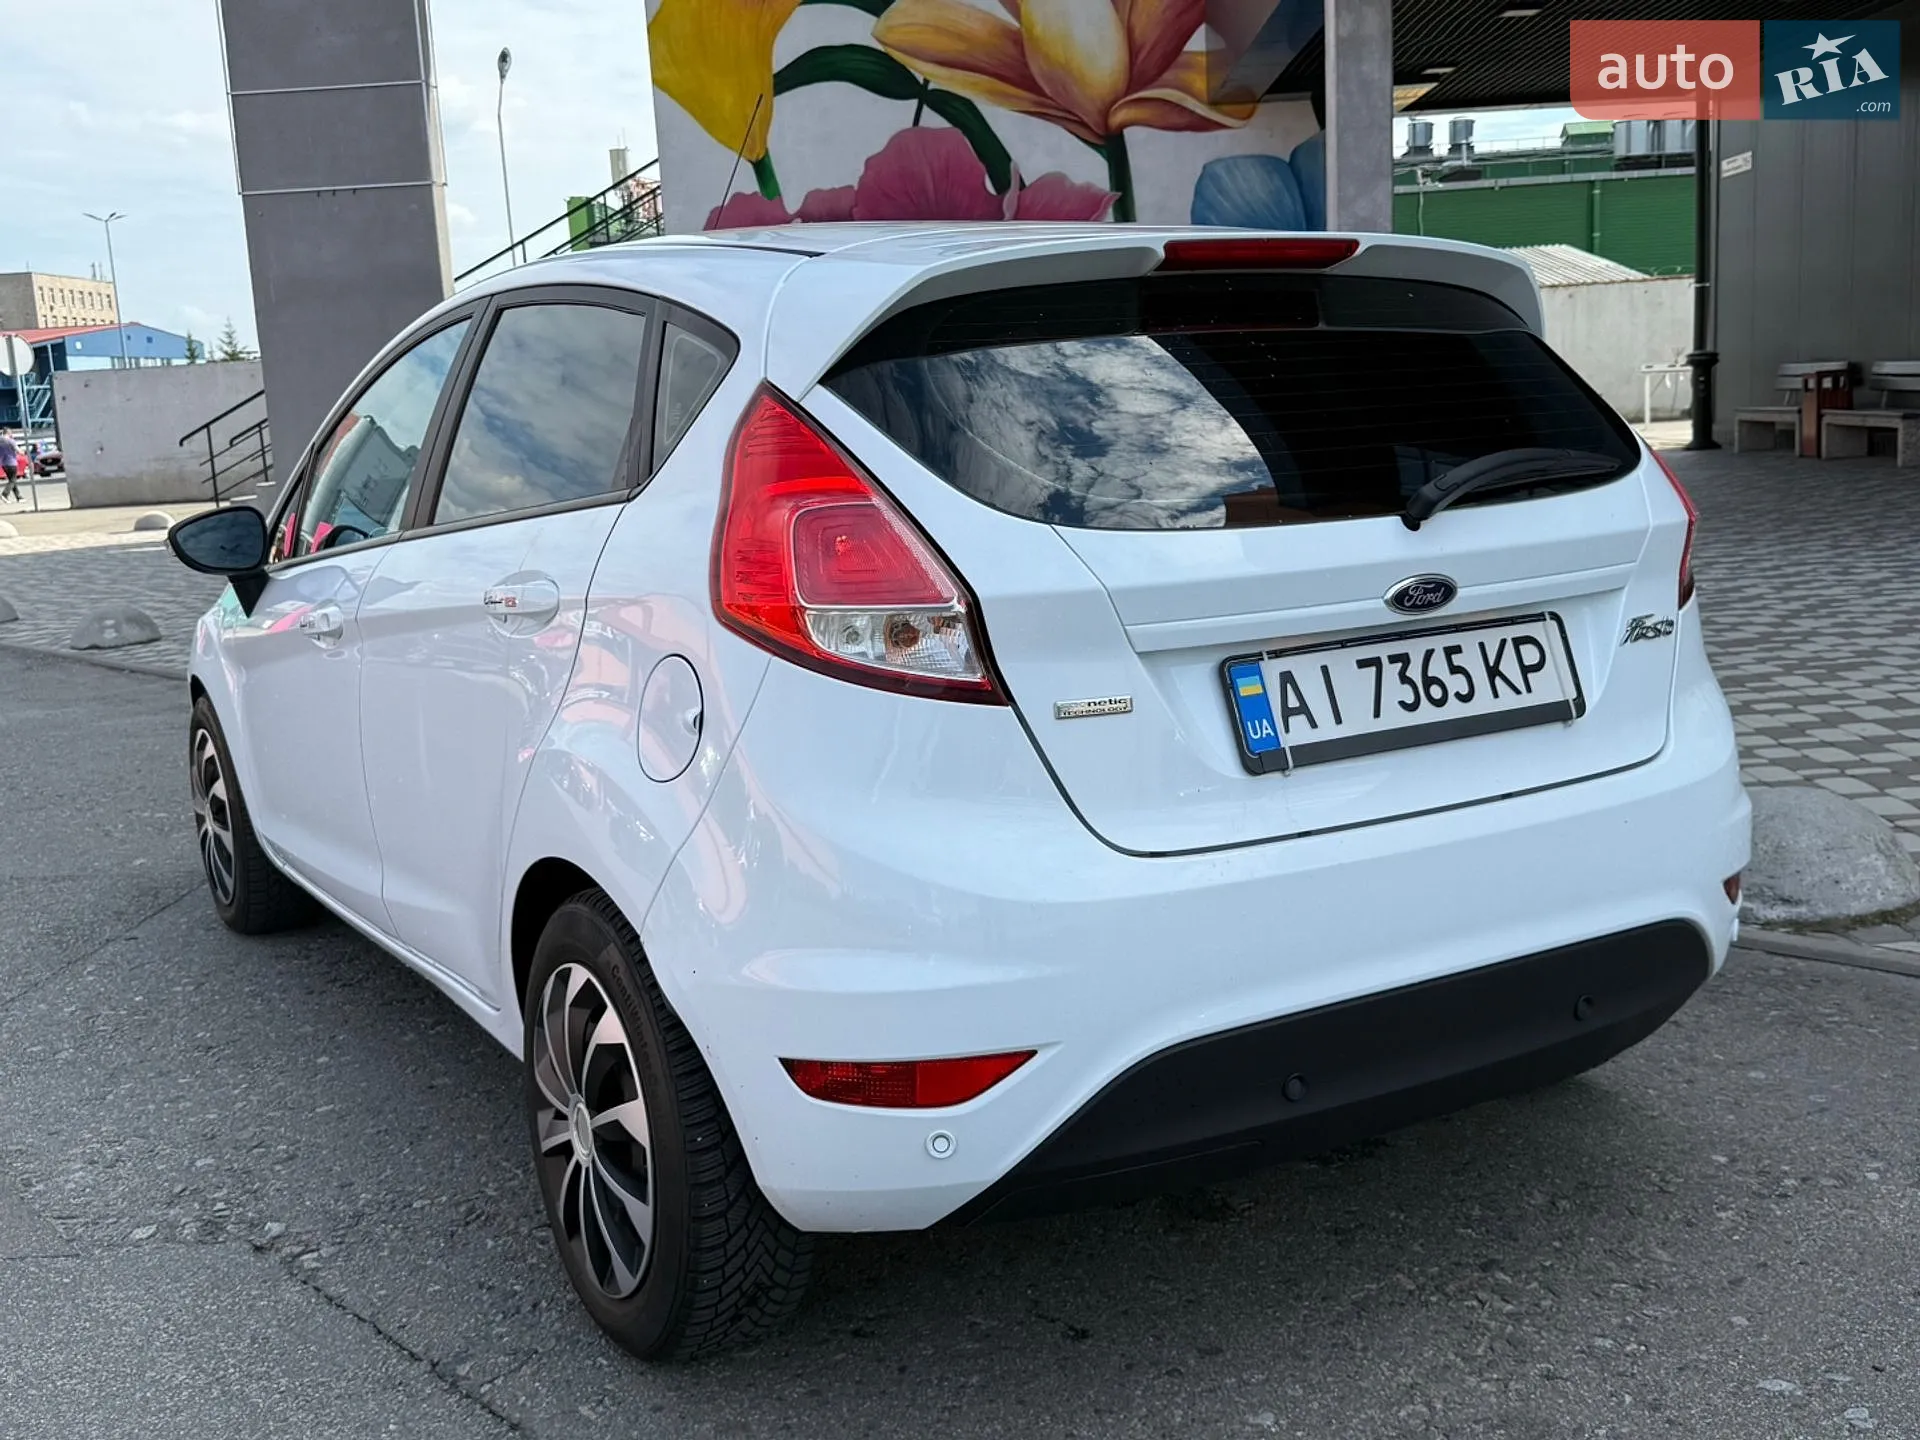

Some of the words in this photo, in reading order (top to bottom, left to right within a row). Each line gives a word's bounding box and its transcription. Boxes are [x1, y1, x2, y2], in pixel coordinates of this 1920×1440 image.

[1403, 583, 1445, 607] Ford
[1279, 664, 1343, 734] AI
[1355, 644, 1475, 719] 7365
[1478, 635, 1547, 699] KP
[1247, 718, 1275, 739] UA
